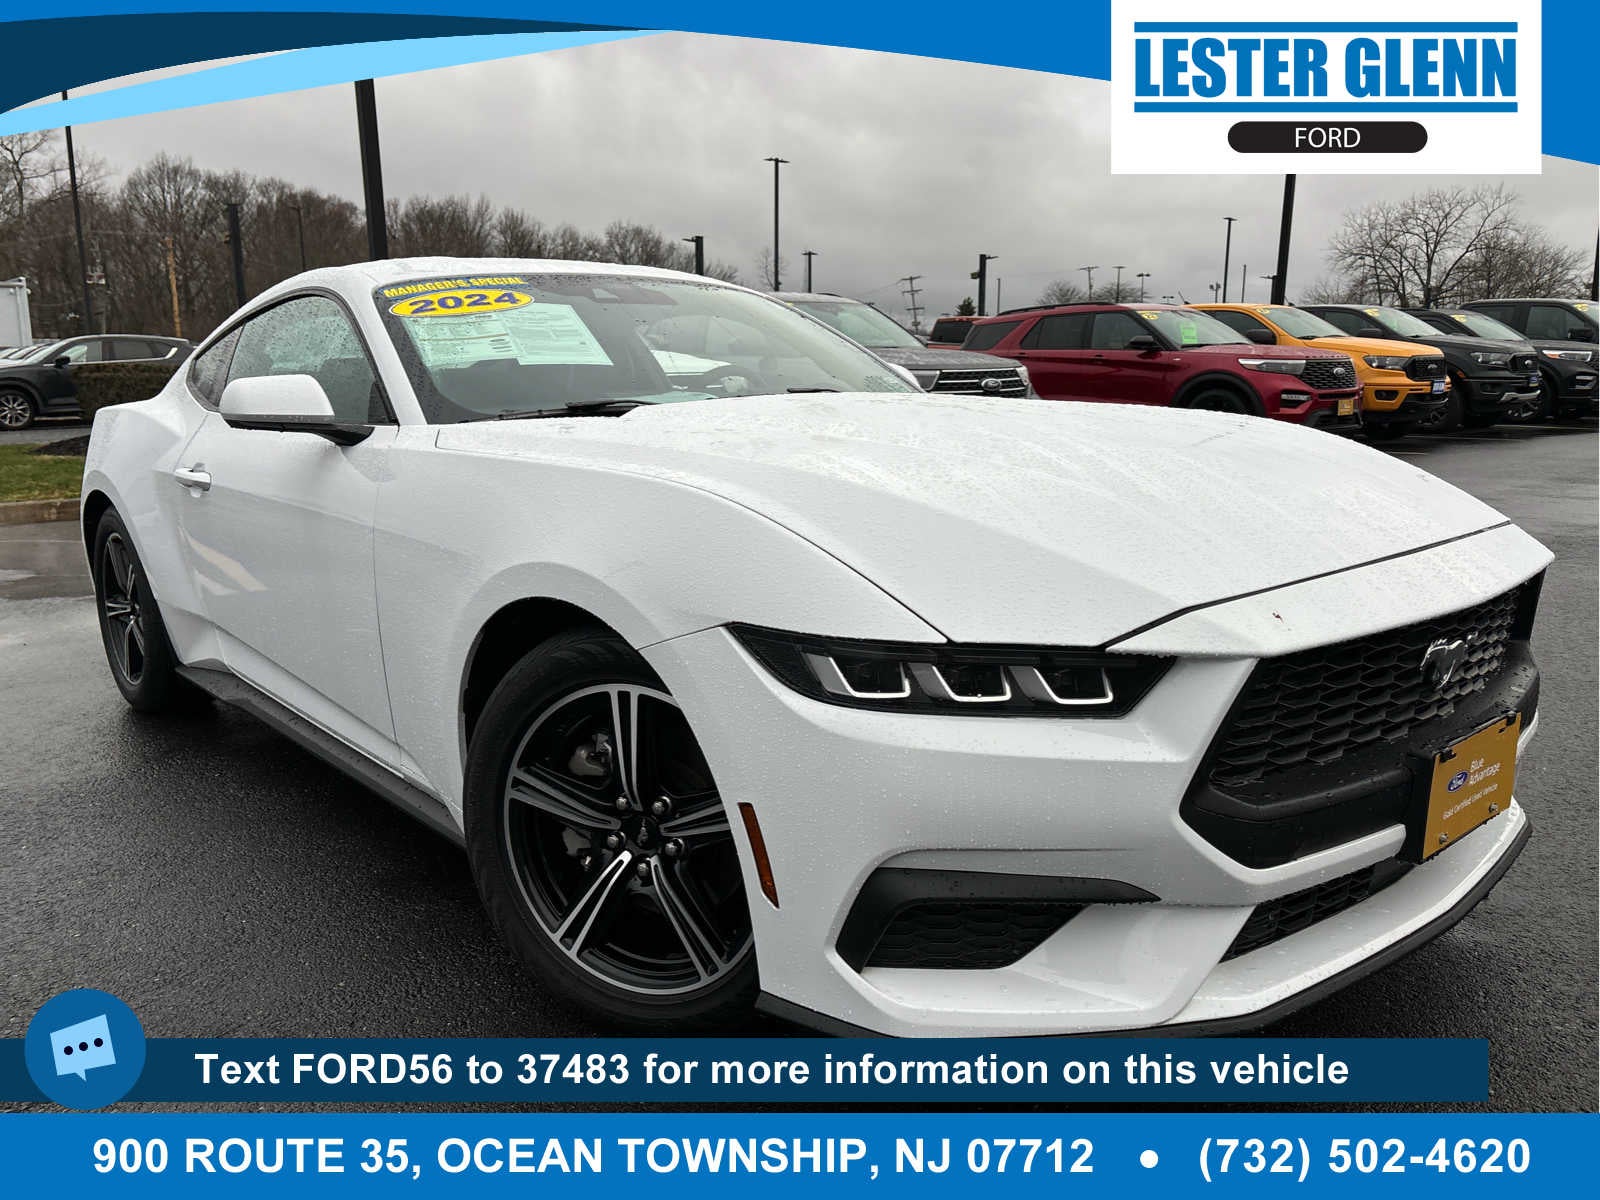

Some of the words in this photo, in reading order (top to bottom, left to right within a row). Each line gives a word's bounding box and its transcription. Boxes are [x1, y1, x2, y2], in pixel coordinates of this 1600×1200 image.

[383, 279, 467, 297] MANAGER'S
[469, 276, 529, 287] SPECIAL
[410, 292, 521, 313] 2024
[1469, 762, 1501, 785] Advantage
[1470, 757, 1485, 773] Blue
